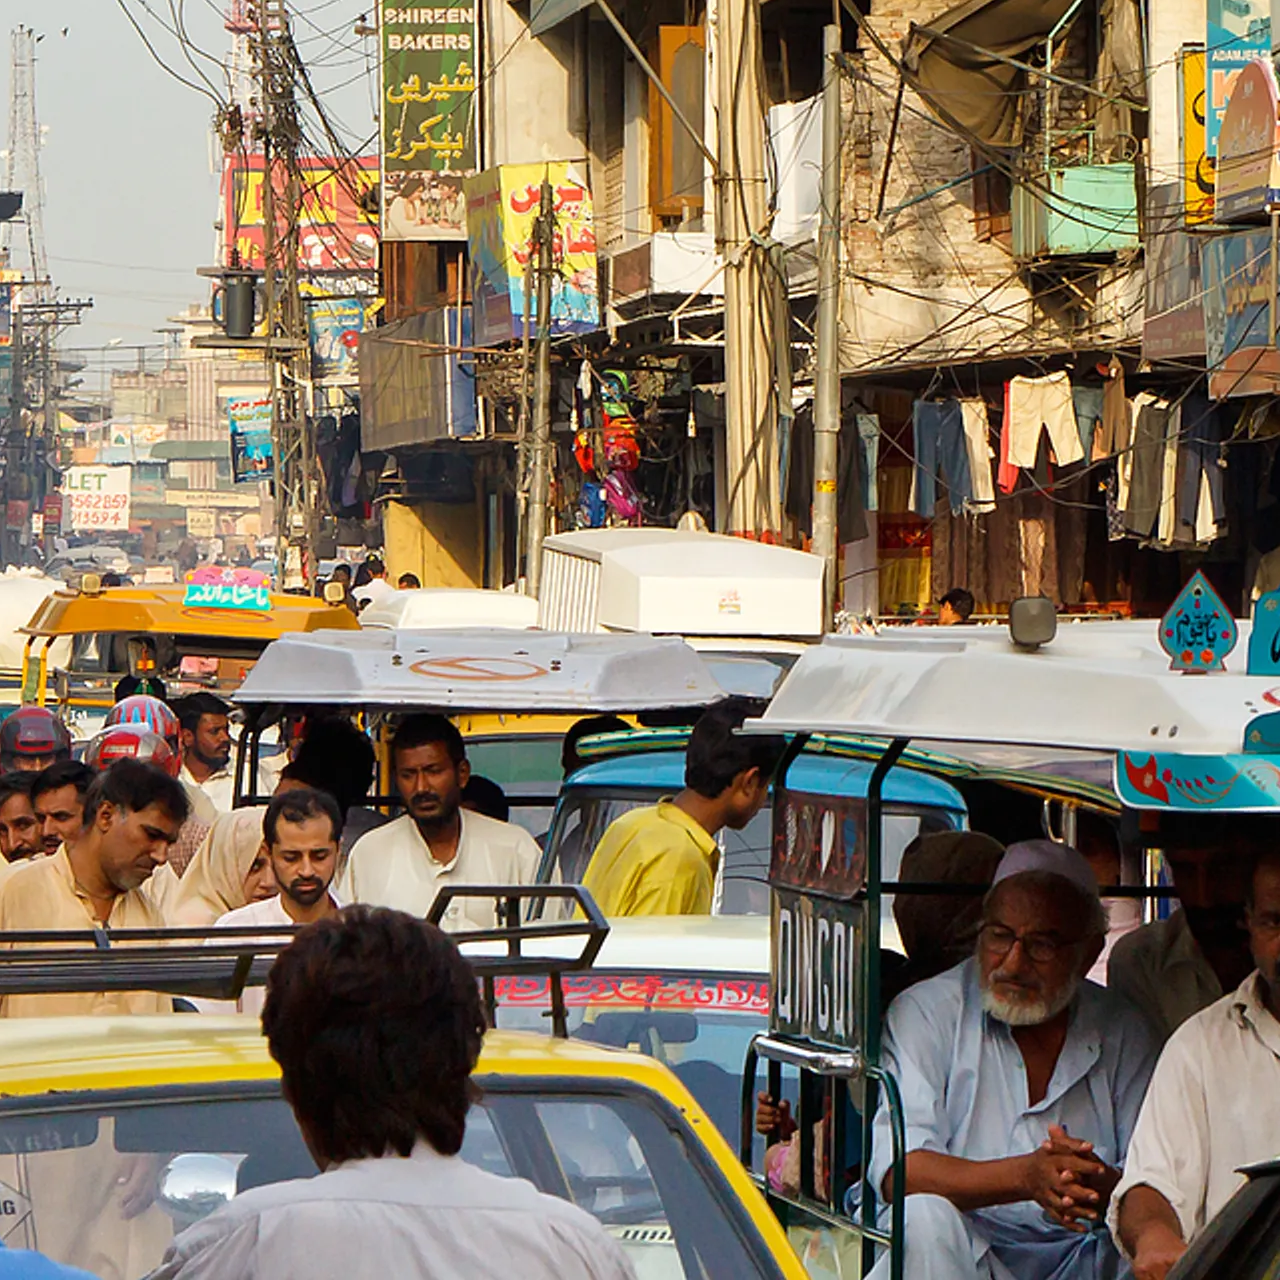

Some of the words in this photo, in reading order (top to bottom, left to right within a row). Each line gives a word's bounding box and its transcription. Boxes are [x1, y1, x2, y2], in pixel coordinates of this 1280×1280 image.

[384, 7, 474, 24] SHIREEN
[387, 33, 472, 51] BAKERS
[67, 473, 108, 491] LET
